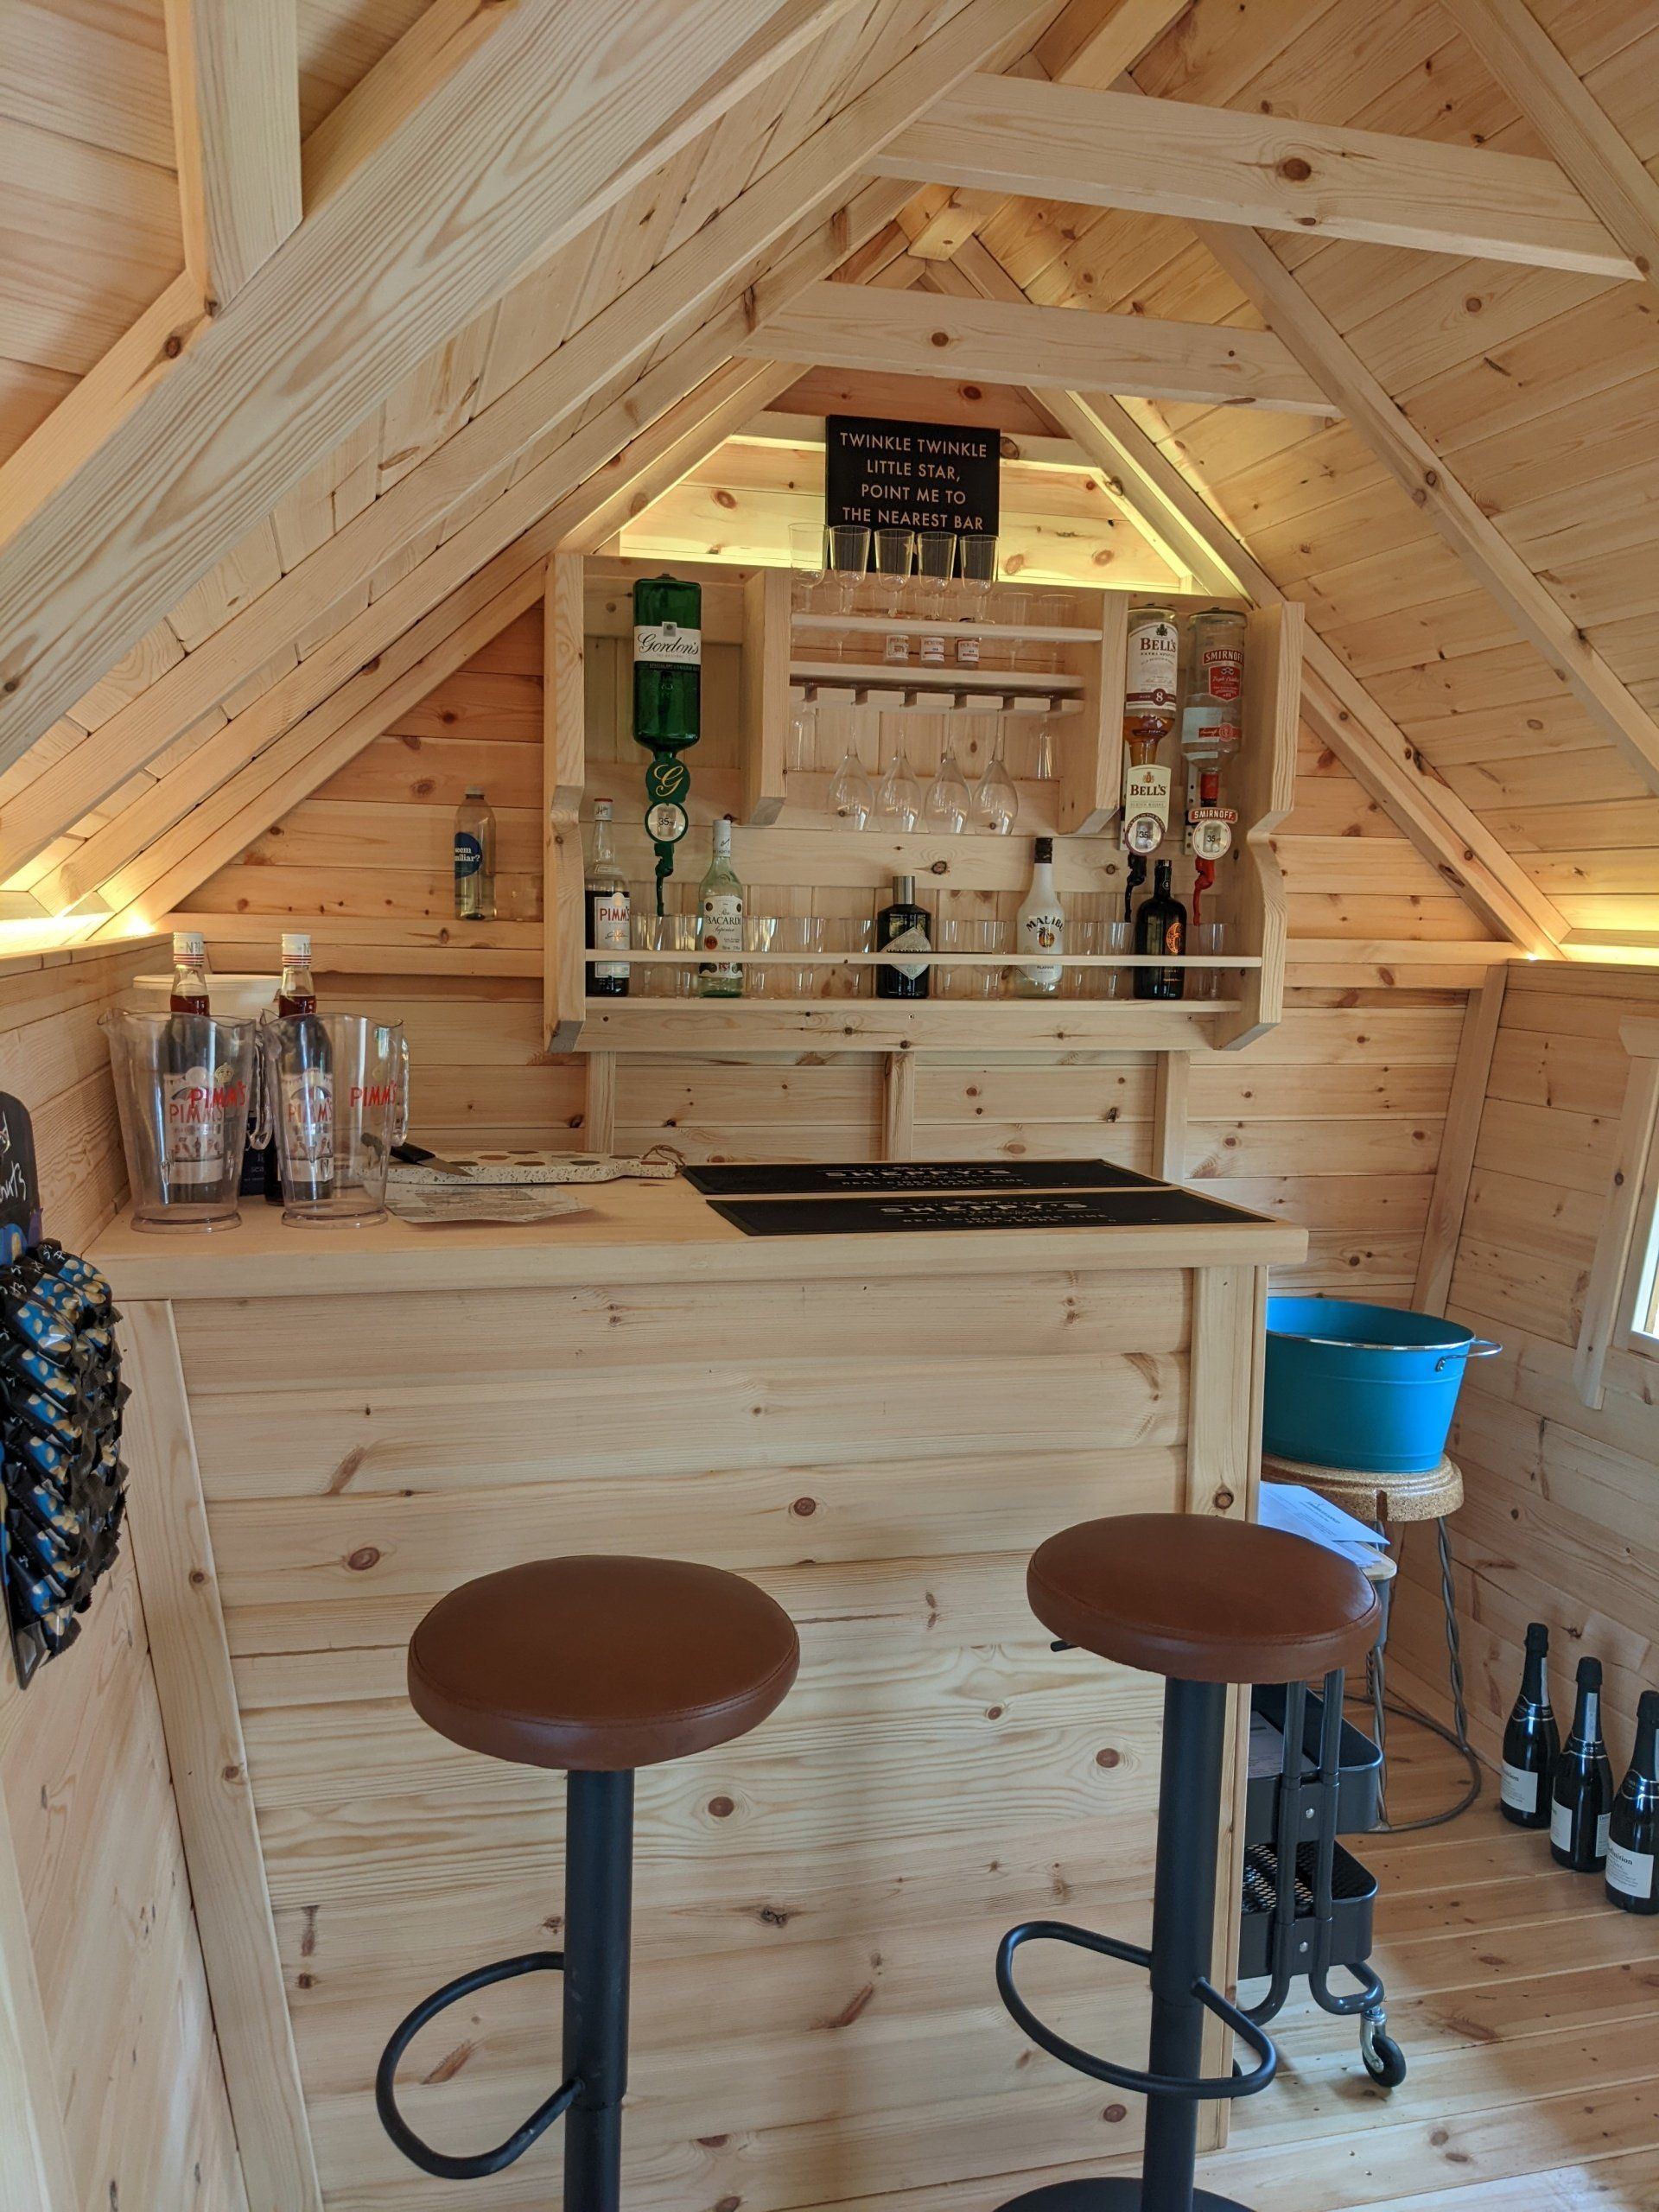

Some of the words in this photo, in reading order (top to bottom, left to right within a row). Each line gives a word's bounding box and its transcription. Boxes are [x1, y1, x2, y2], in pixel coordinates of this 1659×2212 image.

[840, 432, 911, 451] TWINKLE
[918, 439, 987, 458] TWINKLE
[867, 460, 912, 476] LITTLE
[918, 464, 961, 482] STAR,
[861, 484, 910, 501] POINT
[916, 488, 939, 503] ME
[945, 491, 966, 505] TO
[842, 506, 871, 522] THE
[878, 510, 948, 528] NEAREST
[954, 516, 983, 530] BAR
[638, 632, 699, 655] Gordon's
[1140, 637, 1176, 653] BELL'S
[1155, 692, 1164, 702] 8
[654, 764, 683, 797] G
[1130, 784, 1166, 796] BELL'S
[1194, 810, 1233, 819] SMIRNOFF
[706, 916, 741, 925] BACARDI
[1026, 916, 1064, 932] MALIBU
[350, 1080, 397, 1107] PIMM'S
[880, 1203, 1089, 1213] SHEPPY'S
